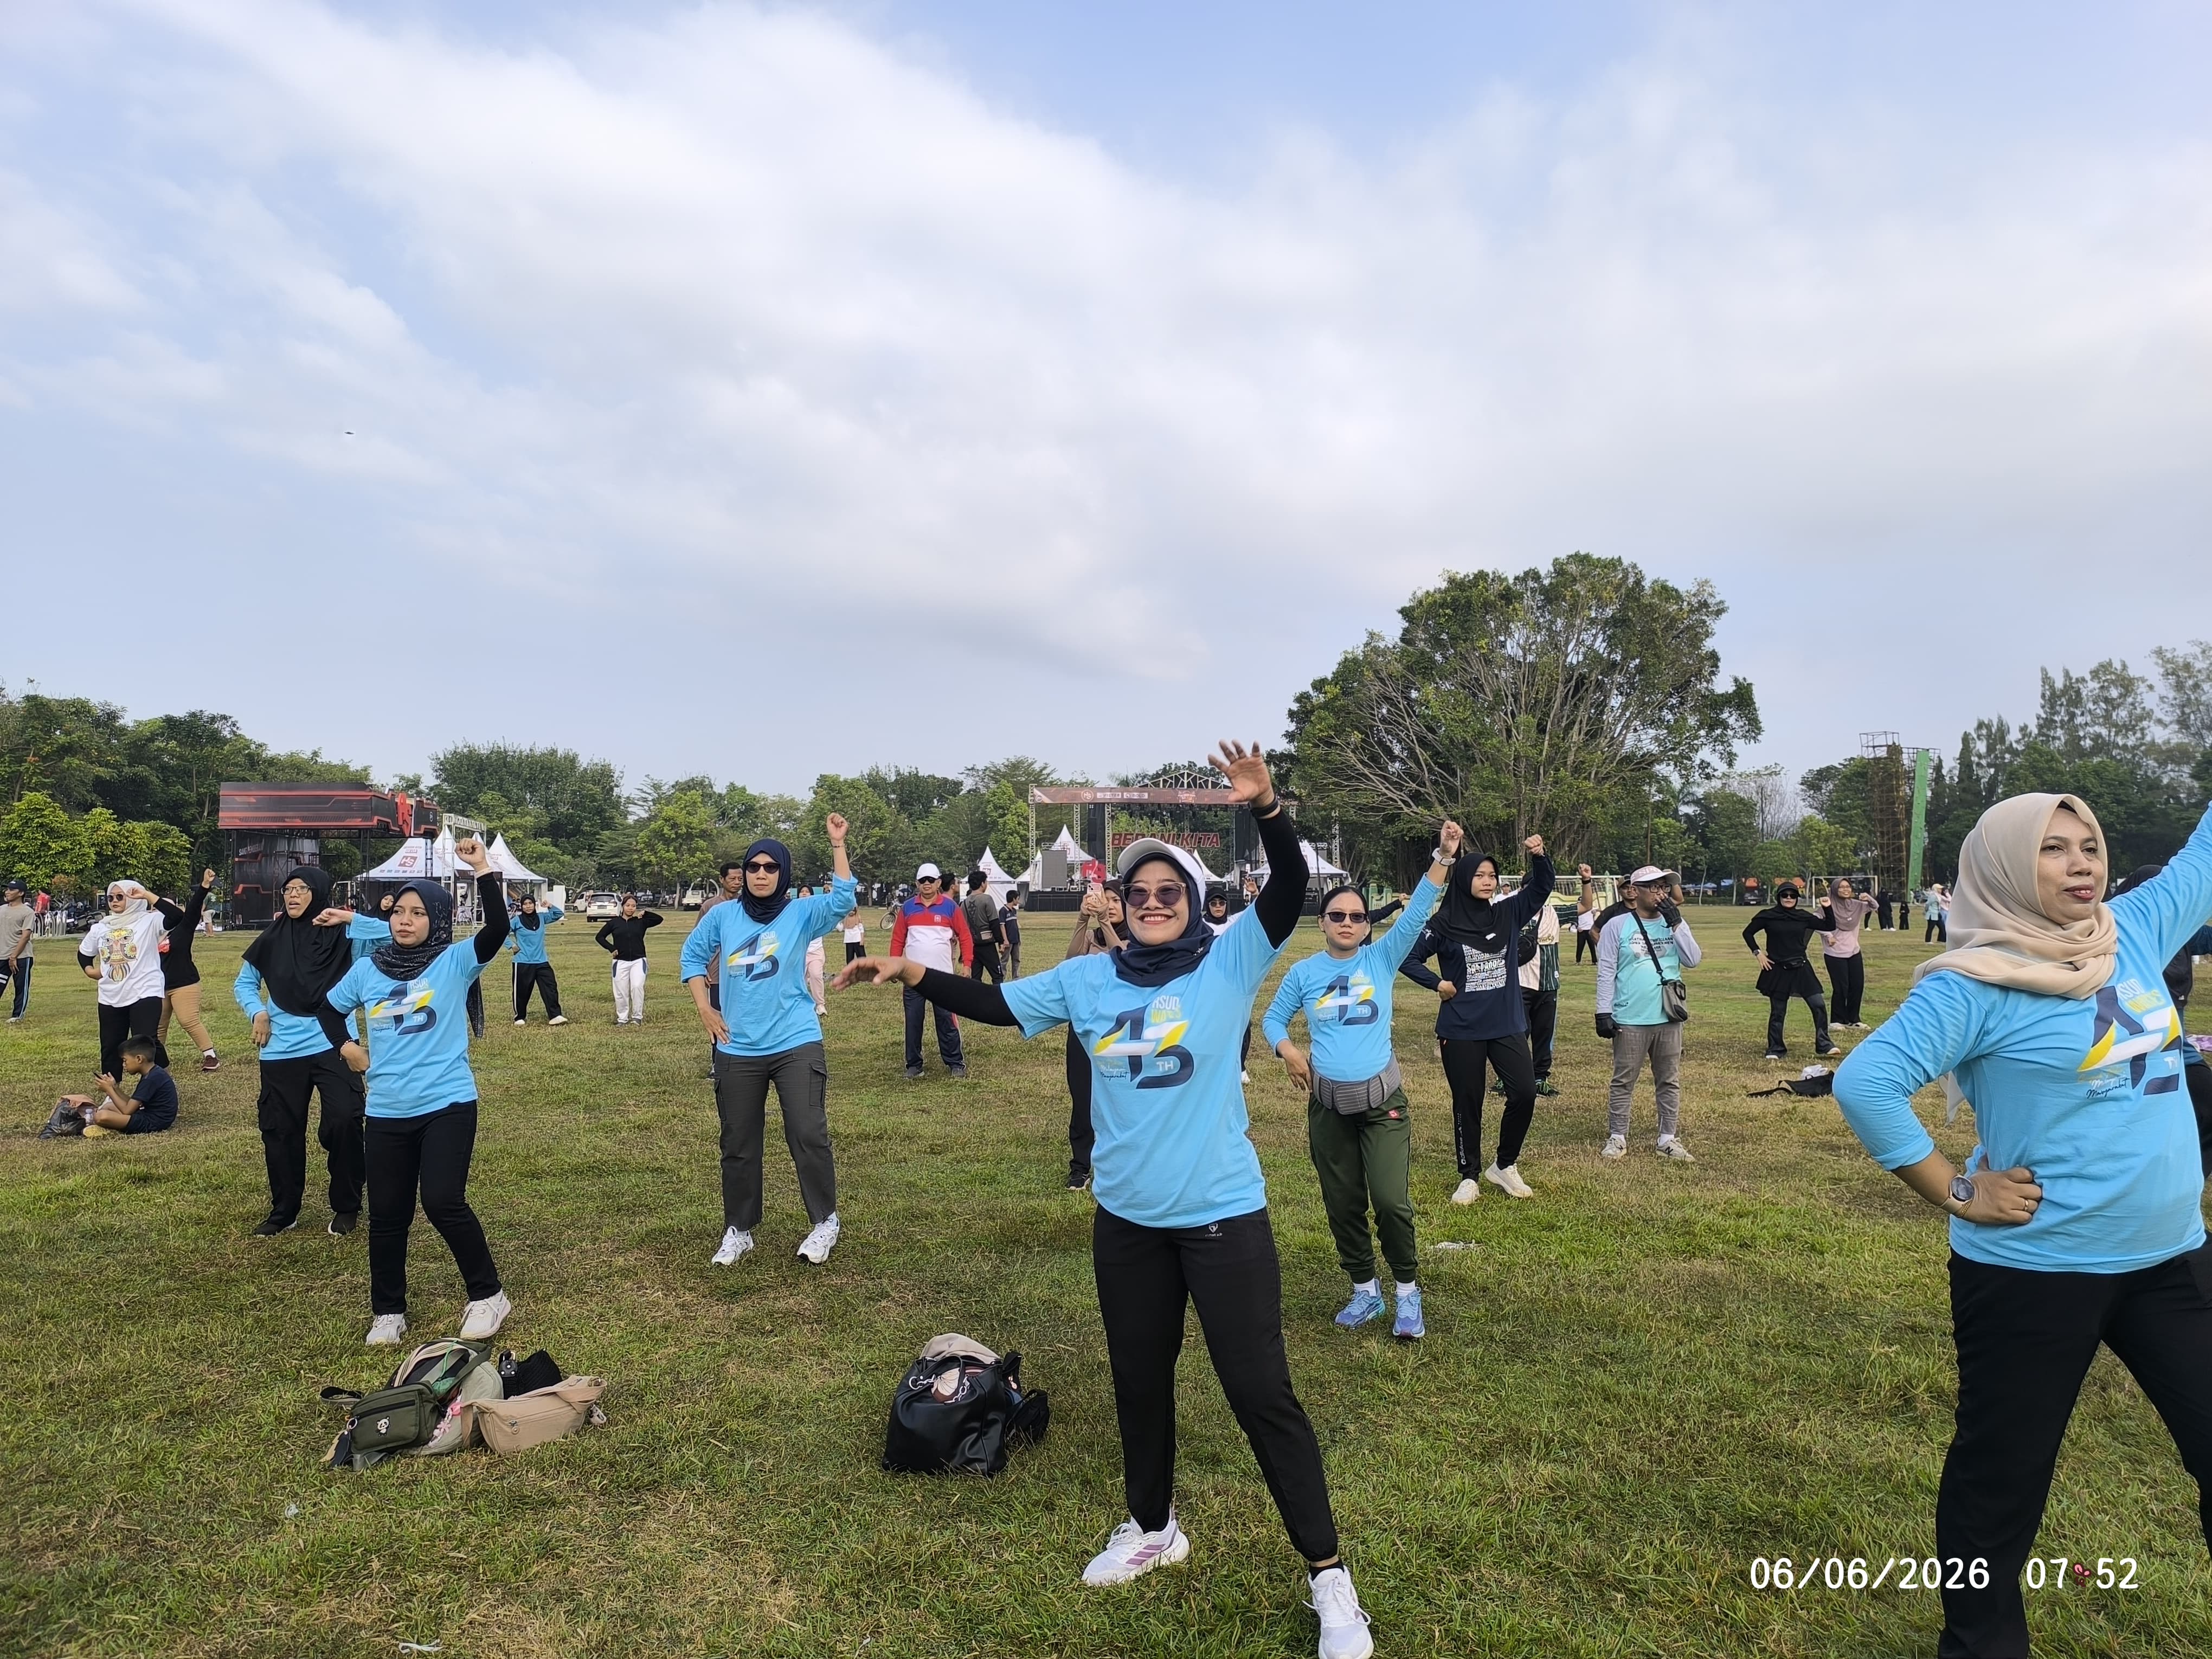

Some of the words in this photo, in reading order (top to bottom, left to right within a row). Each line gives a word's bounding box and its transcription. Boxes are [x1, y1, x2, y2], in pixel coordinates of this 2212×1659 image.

[1180, 833, 1220, 847] KITA
[401, 857, 415, 866] HS
[410, 978, 428, 989] RSUD
[1152, 995, 1180, 1009] RSUD
[1156, 1060, 1174, 1071] TH
